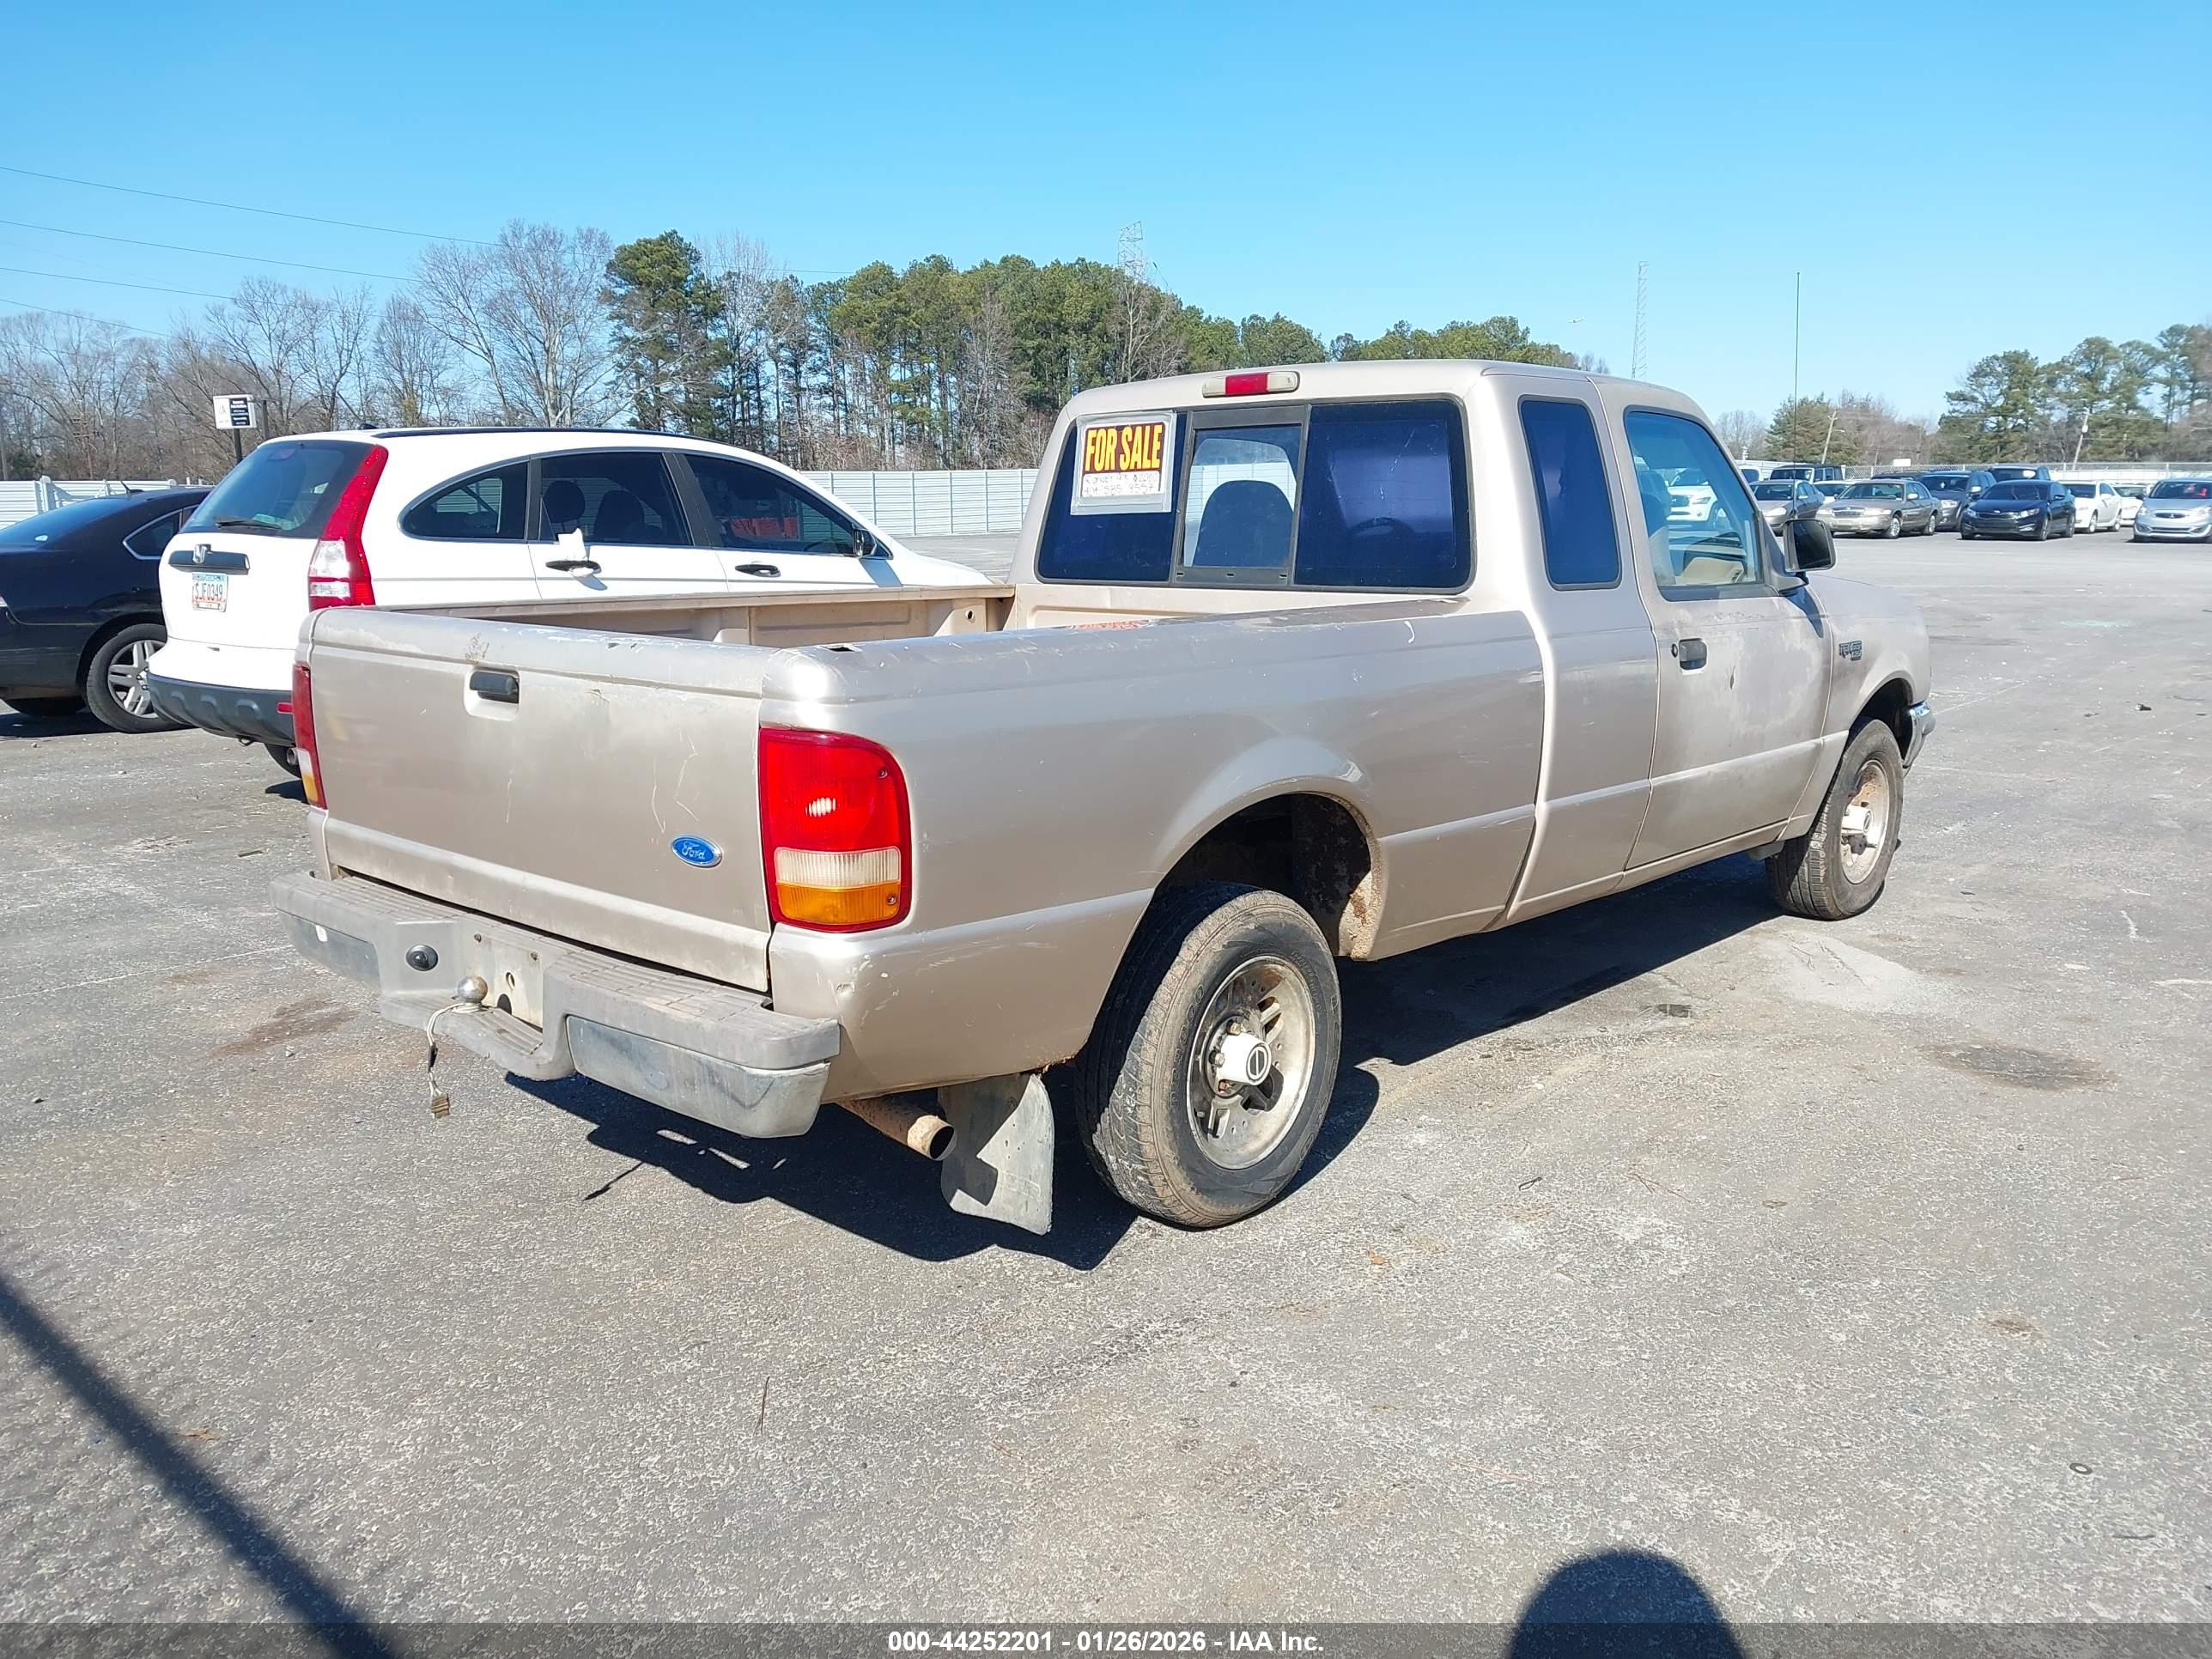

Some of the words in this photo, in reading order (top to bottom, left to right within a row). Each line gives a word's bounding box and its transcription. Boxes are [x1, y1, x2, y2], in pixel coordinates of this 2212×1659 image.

[1085, 428, 1117, 471] FOR
[1119, 424, 1163, 471] SALE
[681, 841, 706, 860] Ford
